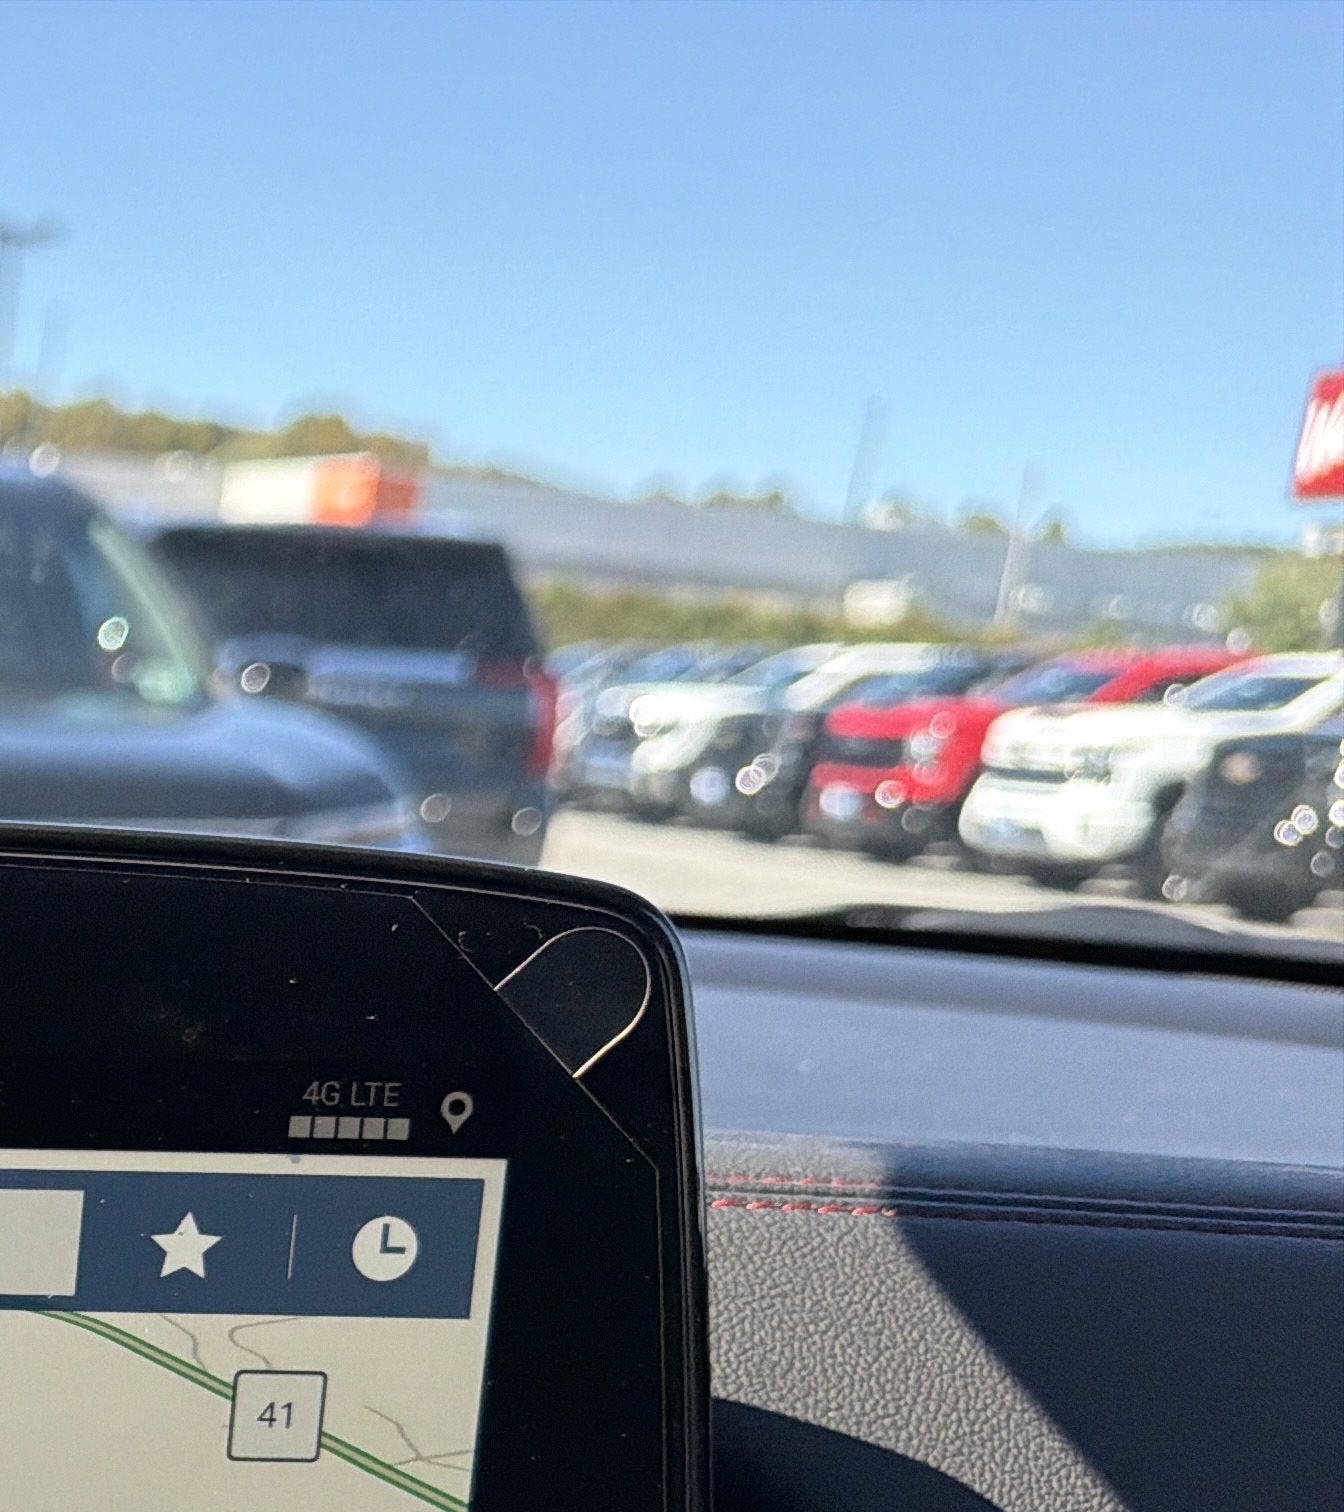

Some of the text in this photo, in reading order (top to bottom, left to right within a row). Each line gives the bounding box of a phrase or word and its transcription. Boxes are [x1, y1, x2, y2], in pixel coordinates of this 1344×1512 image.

[302, 1080, 402, 1107] 4G LTE
[256, 1401, 293, 1429] 41
